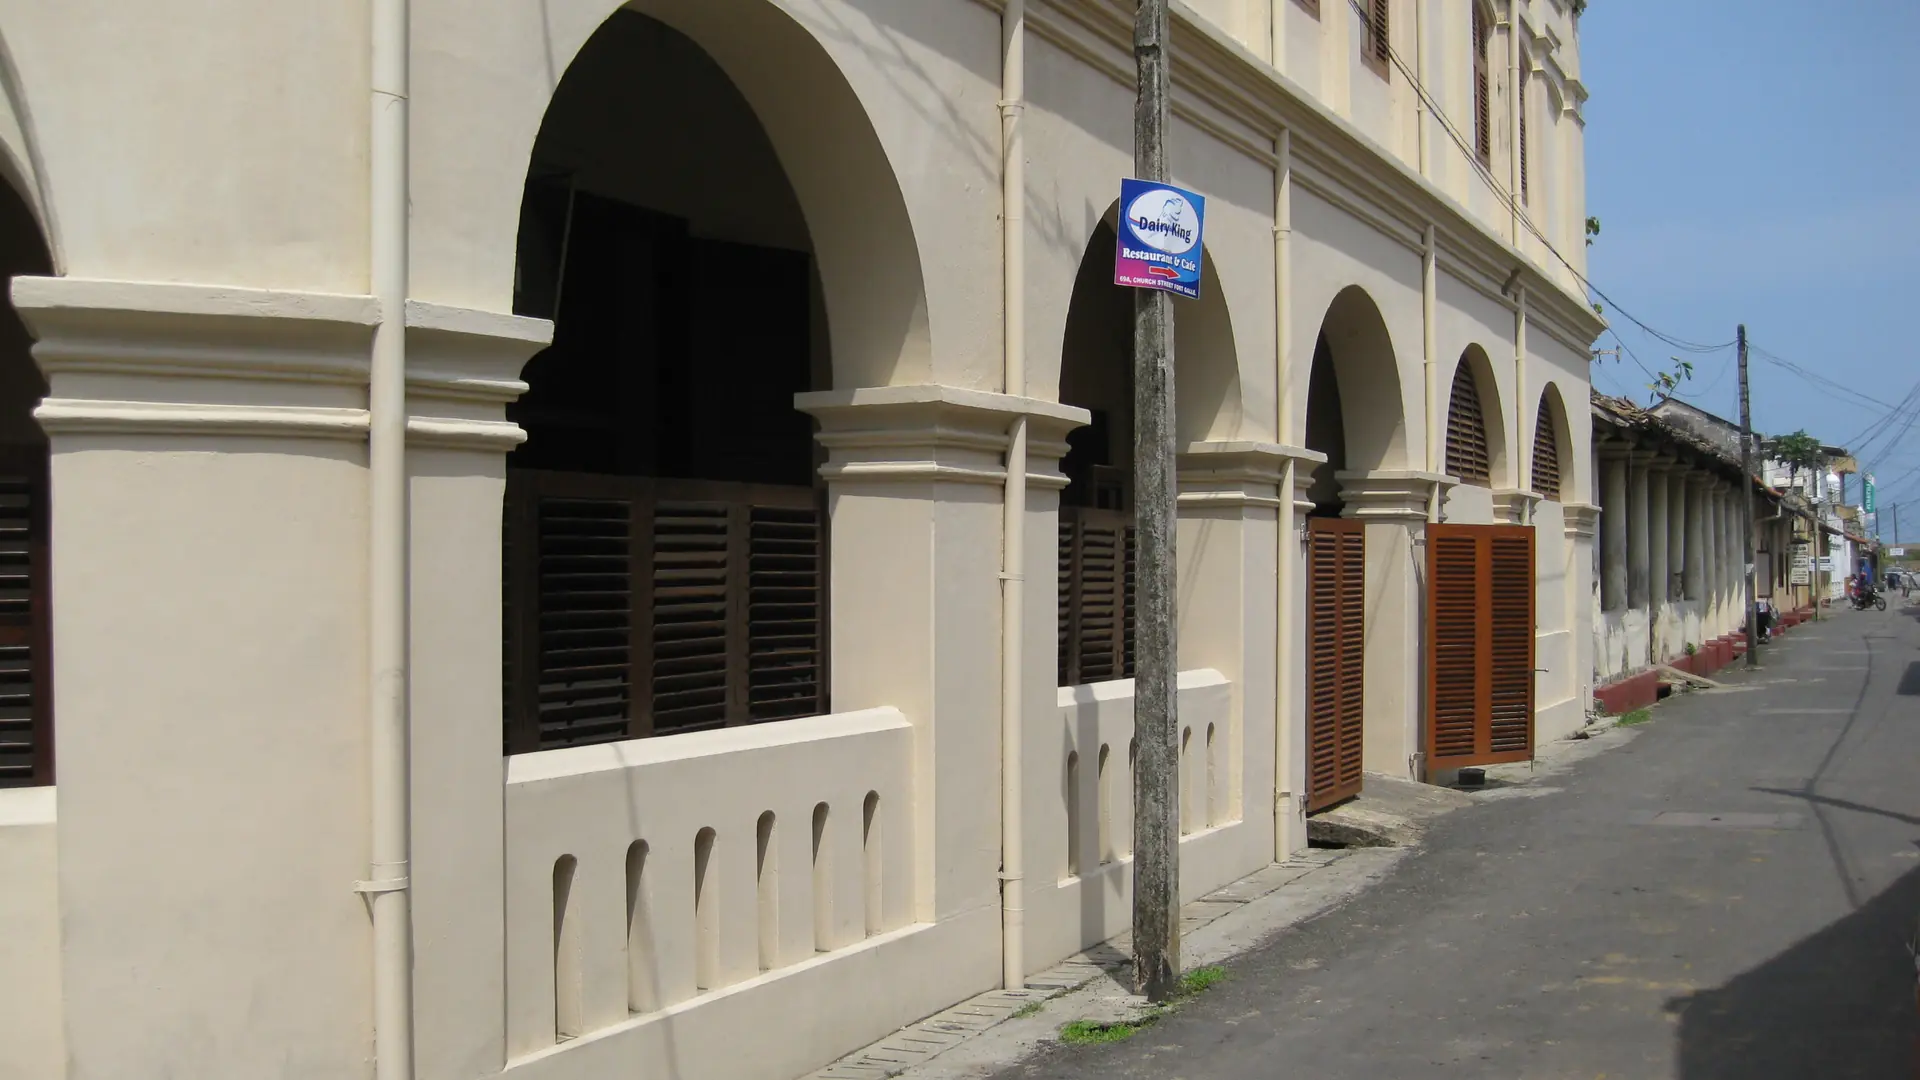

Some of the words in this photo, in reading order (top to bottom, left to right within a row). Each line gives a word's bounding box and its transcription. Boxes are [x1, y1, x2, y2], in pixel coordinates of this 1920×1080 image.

[1140, 216, 1170, 236] Dairy
[1171, 222, 1192, 244] King
[1123, 248, 1172, 264] Restaurant
[1174, 257, 1180, 266] &
[1133, 277, 1156, 285] CHURCH
[1157, 280, 1174, 288] STREET
